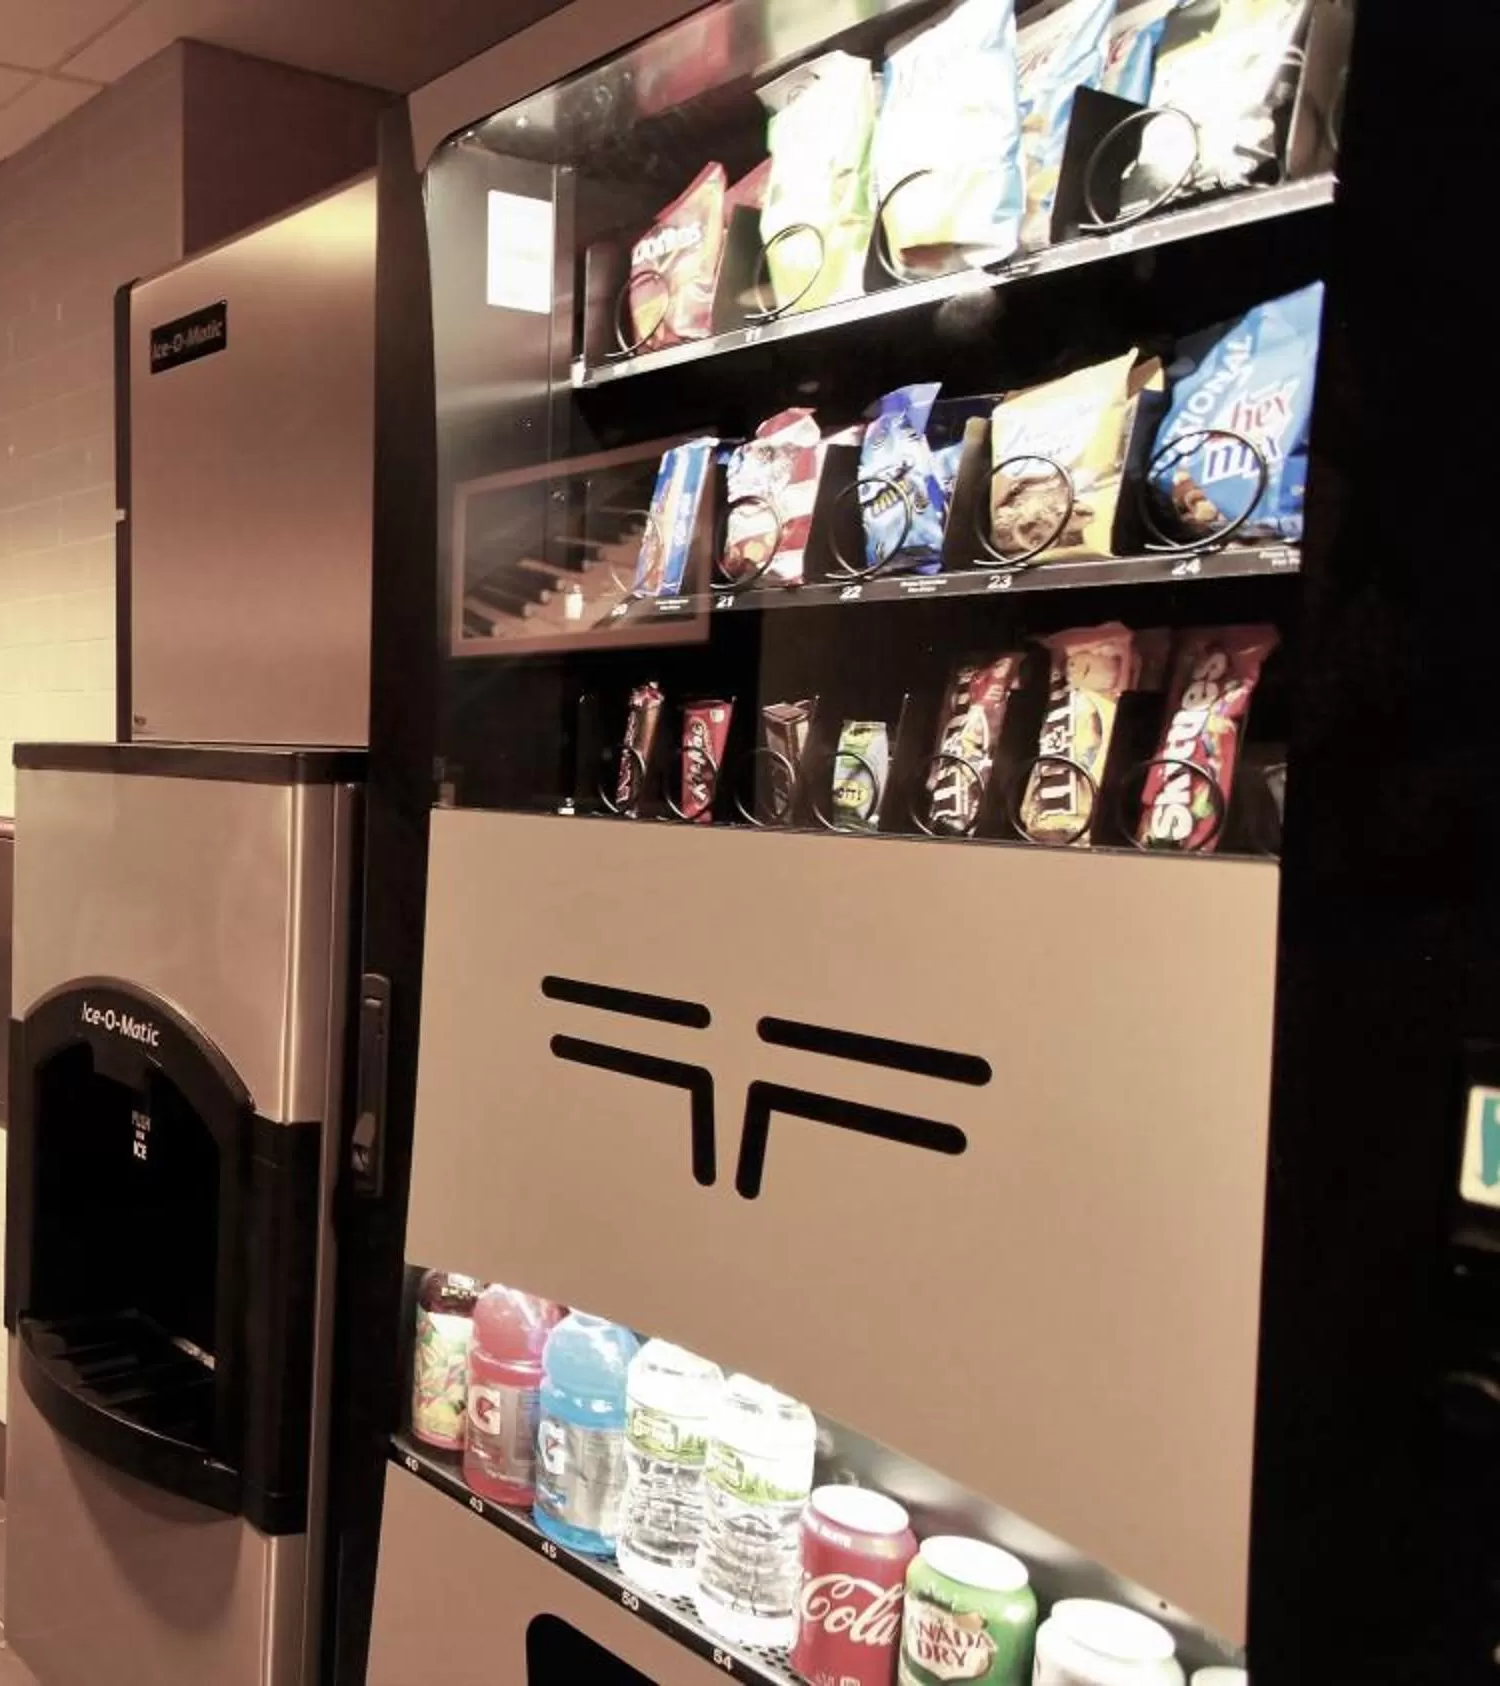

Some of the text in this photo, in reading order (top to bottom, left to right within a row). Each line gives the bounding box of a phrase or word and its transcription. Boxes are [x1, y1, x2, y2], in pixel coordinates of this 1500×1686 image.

[1171, 557, 1200, 575] 24
[987, 574, 1012, 590] 23
[839, 584, 864, 600] 22
[715, 595, 735, 609] 21
[81, 1001, 160, 1047] Ice-O-Matic
[132, 1140, 148, 1161] ICE
[917, 1639, 967, 1669] DRY
